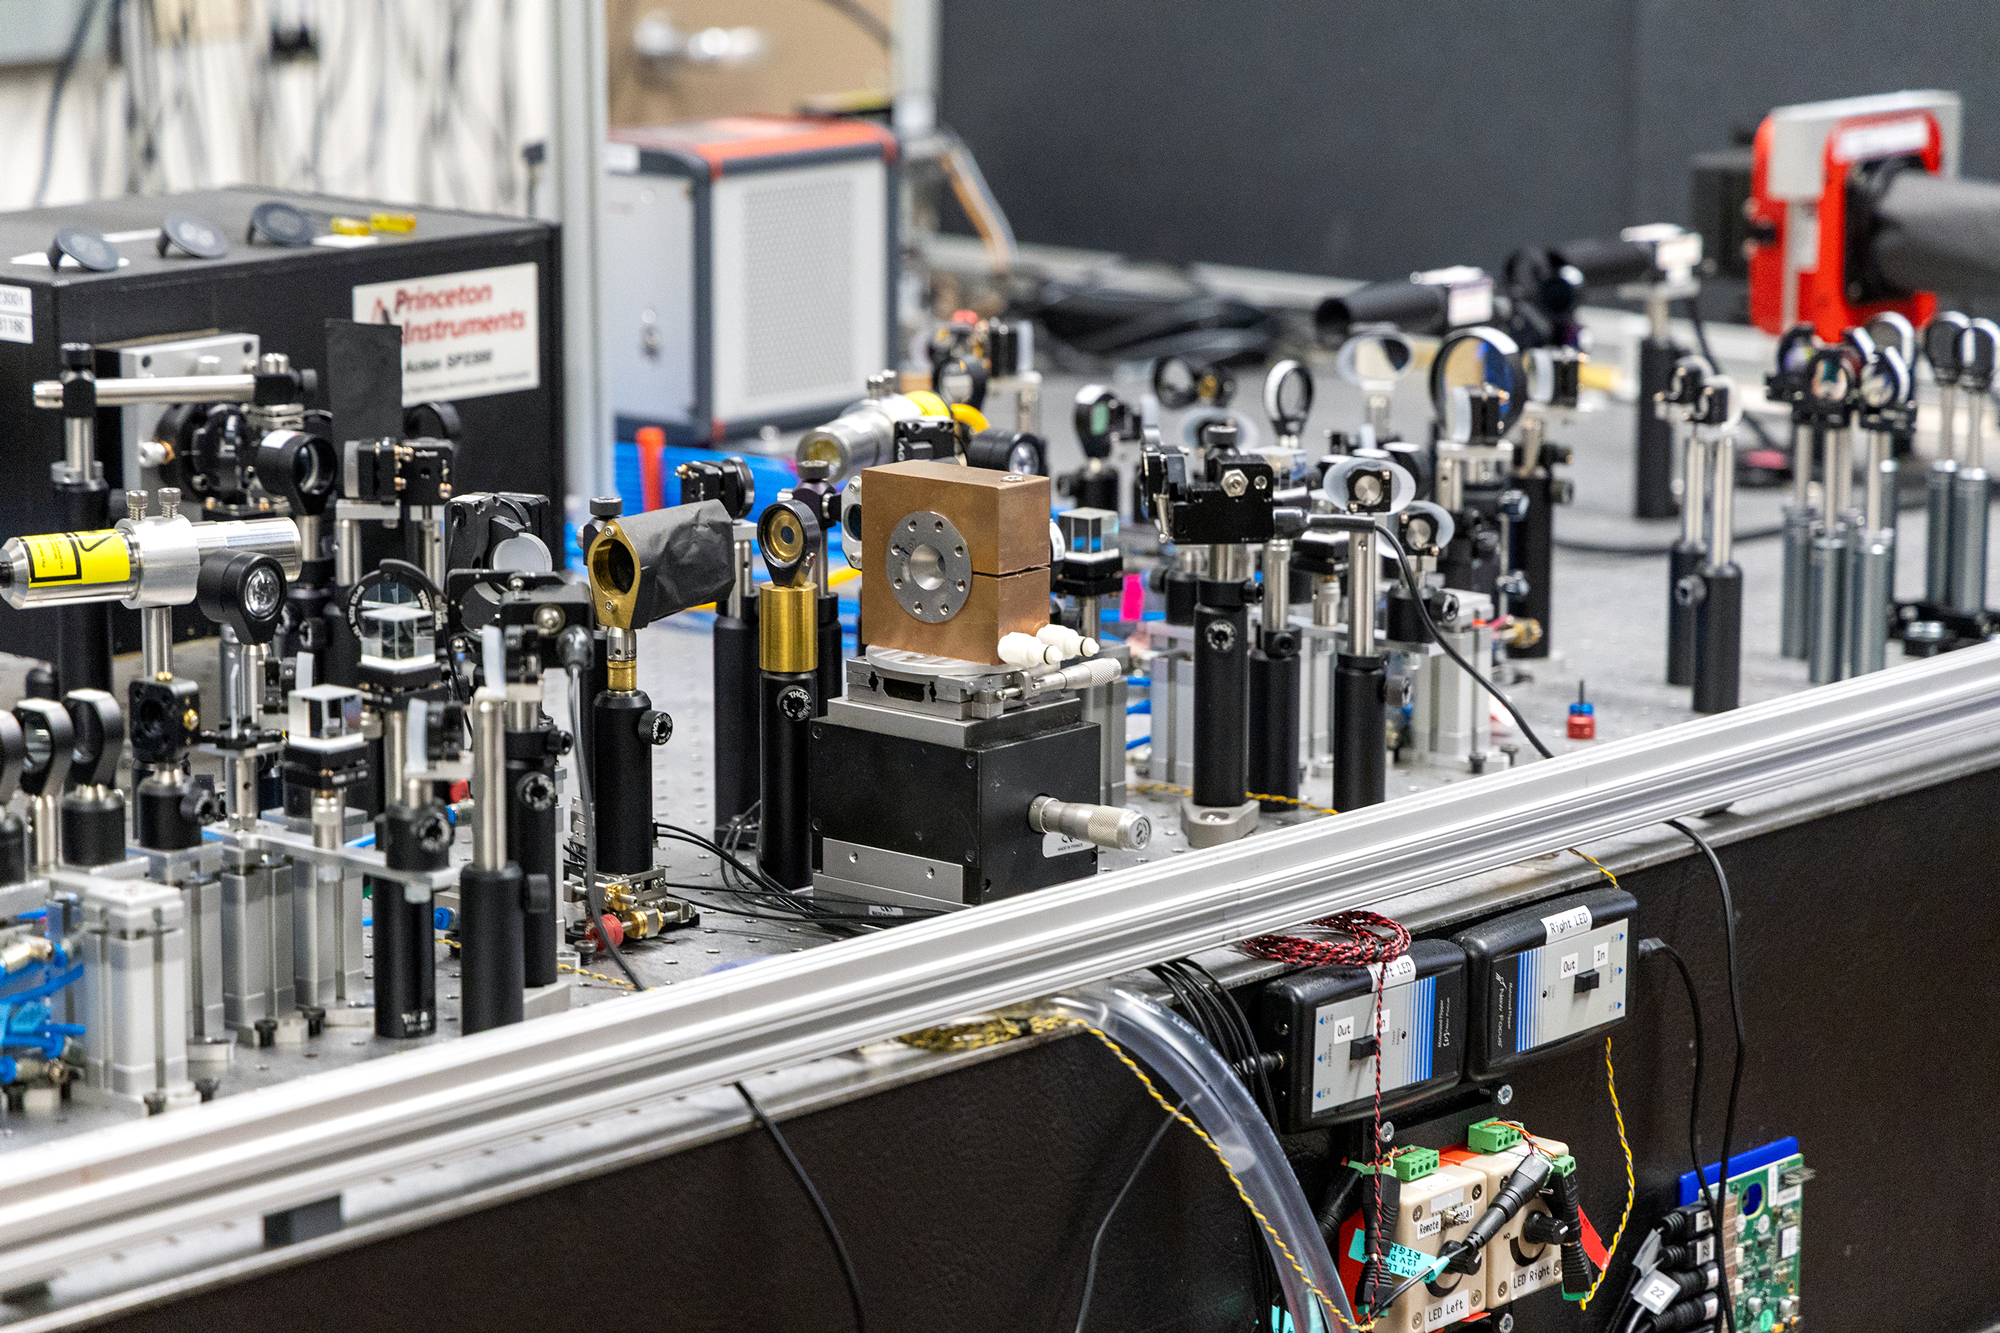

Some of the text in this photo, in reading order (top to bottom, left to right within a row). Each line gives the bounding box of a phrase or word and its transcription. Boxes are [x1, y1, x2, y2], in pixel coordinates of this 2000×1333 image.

[395, 285, 493, 313] Princeton
[404, 312, 524, 344] Instruments
[1549, 912, 1588, 934] Right LED
[1597, 950, 1606, 961] In
[1375, 962, 1412, 980] Lft LED
[1563, 960, 1576, 973] Out
[1337, 1023, 1351, 1037] Out
[1419, 1220, 1439, 1235] Remote
[1390, 1242, 1421, 1261] RIGH
[1513, 1262, 1551, 1289] LED Right
[1650, 1286, 1666, 1300] 22
[1428, 1299, 1464, 1323] LED Left
